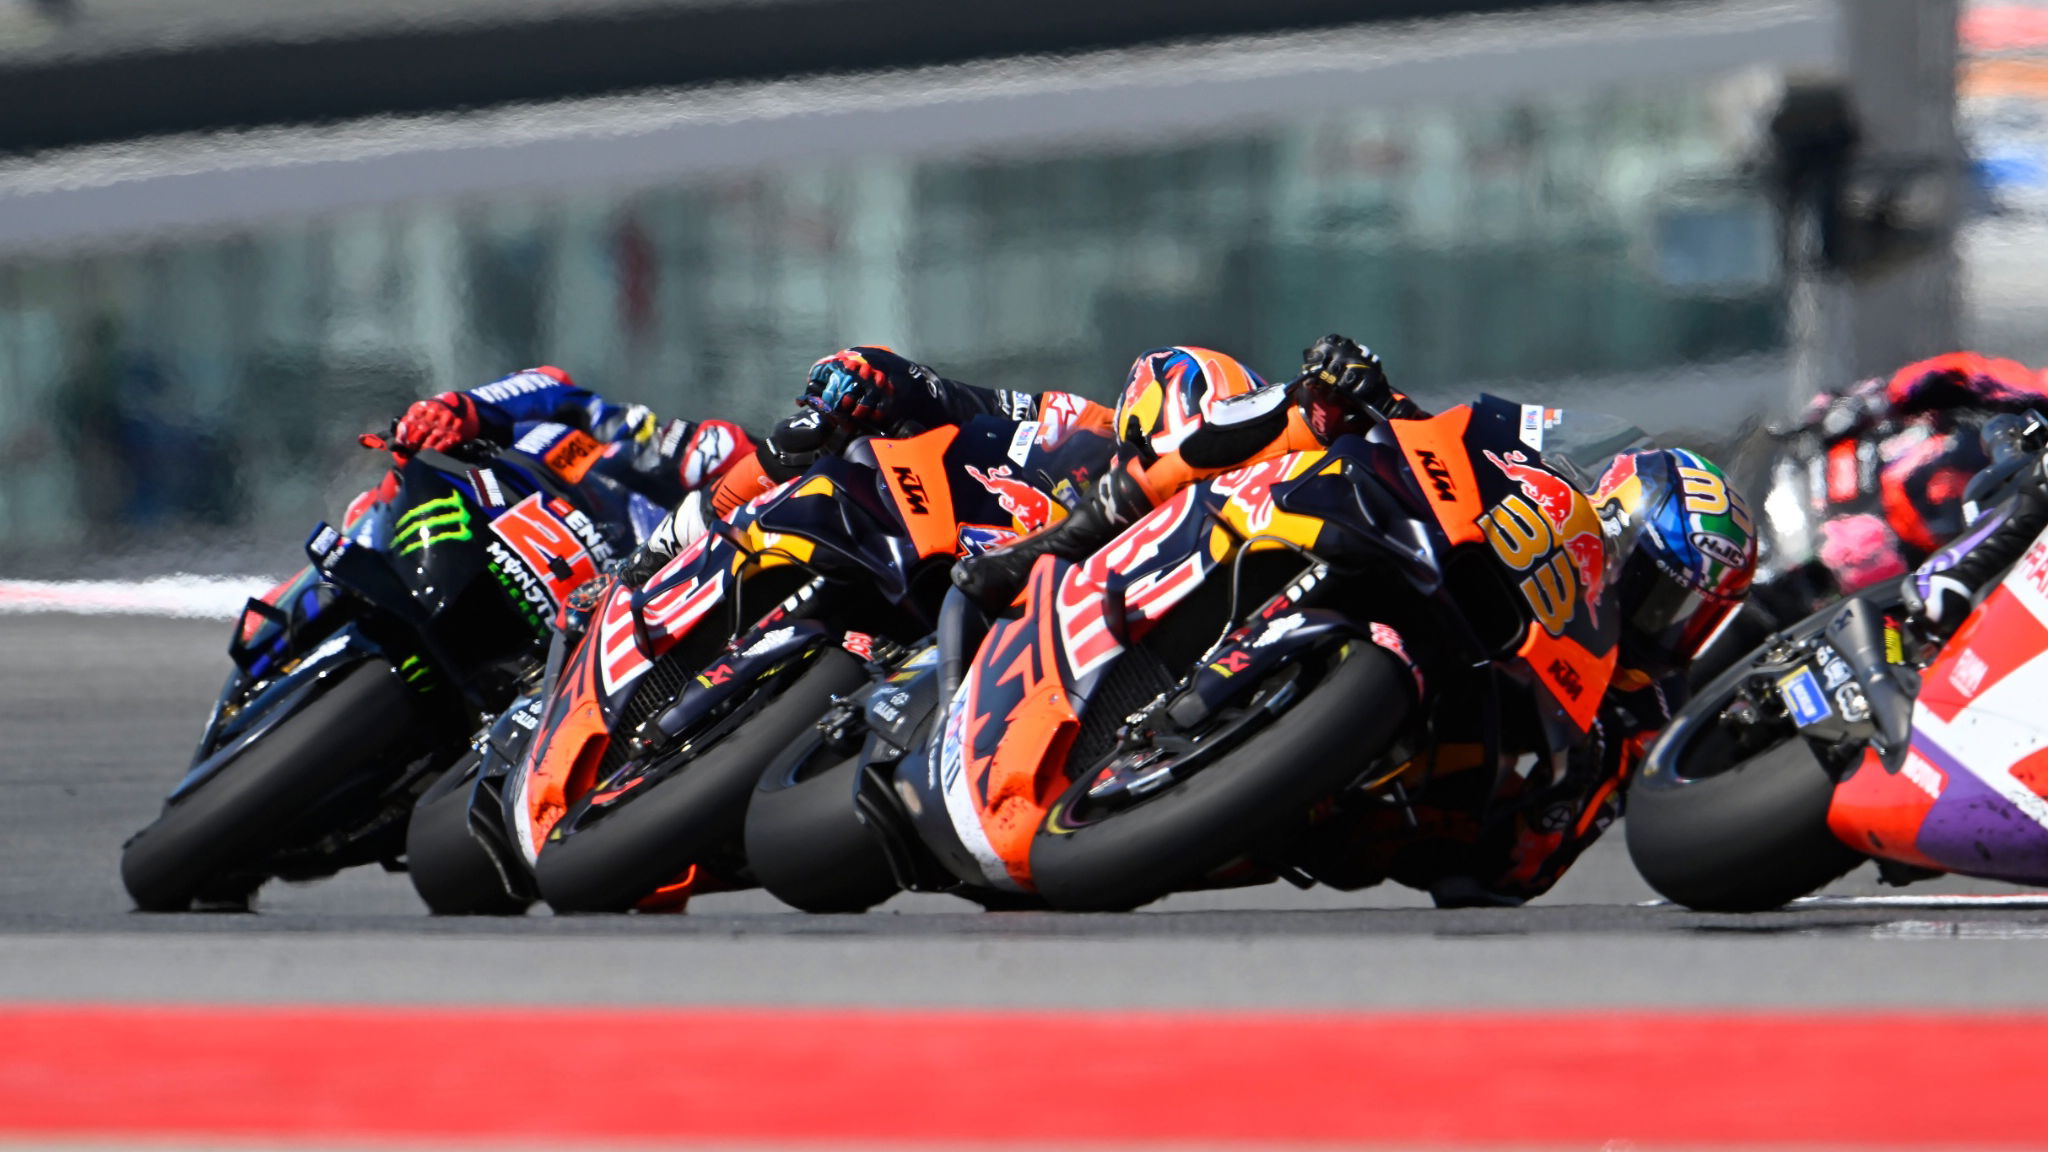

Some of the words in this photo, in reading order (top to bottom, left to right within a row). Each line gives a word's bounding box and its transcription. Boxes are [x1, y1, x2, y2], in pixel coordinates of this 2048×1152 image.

[892, 466, 929, 516] KTM
[1415, 449, 1457, 503] KTM
[1474, 493, 1577, 637] 33
[1698, 536, 1744, 565] HJC
[1547, 659, 1584, 702] KTM
